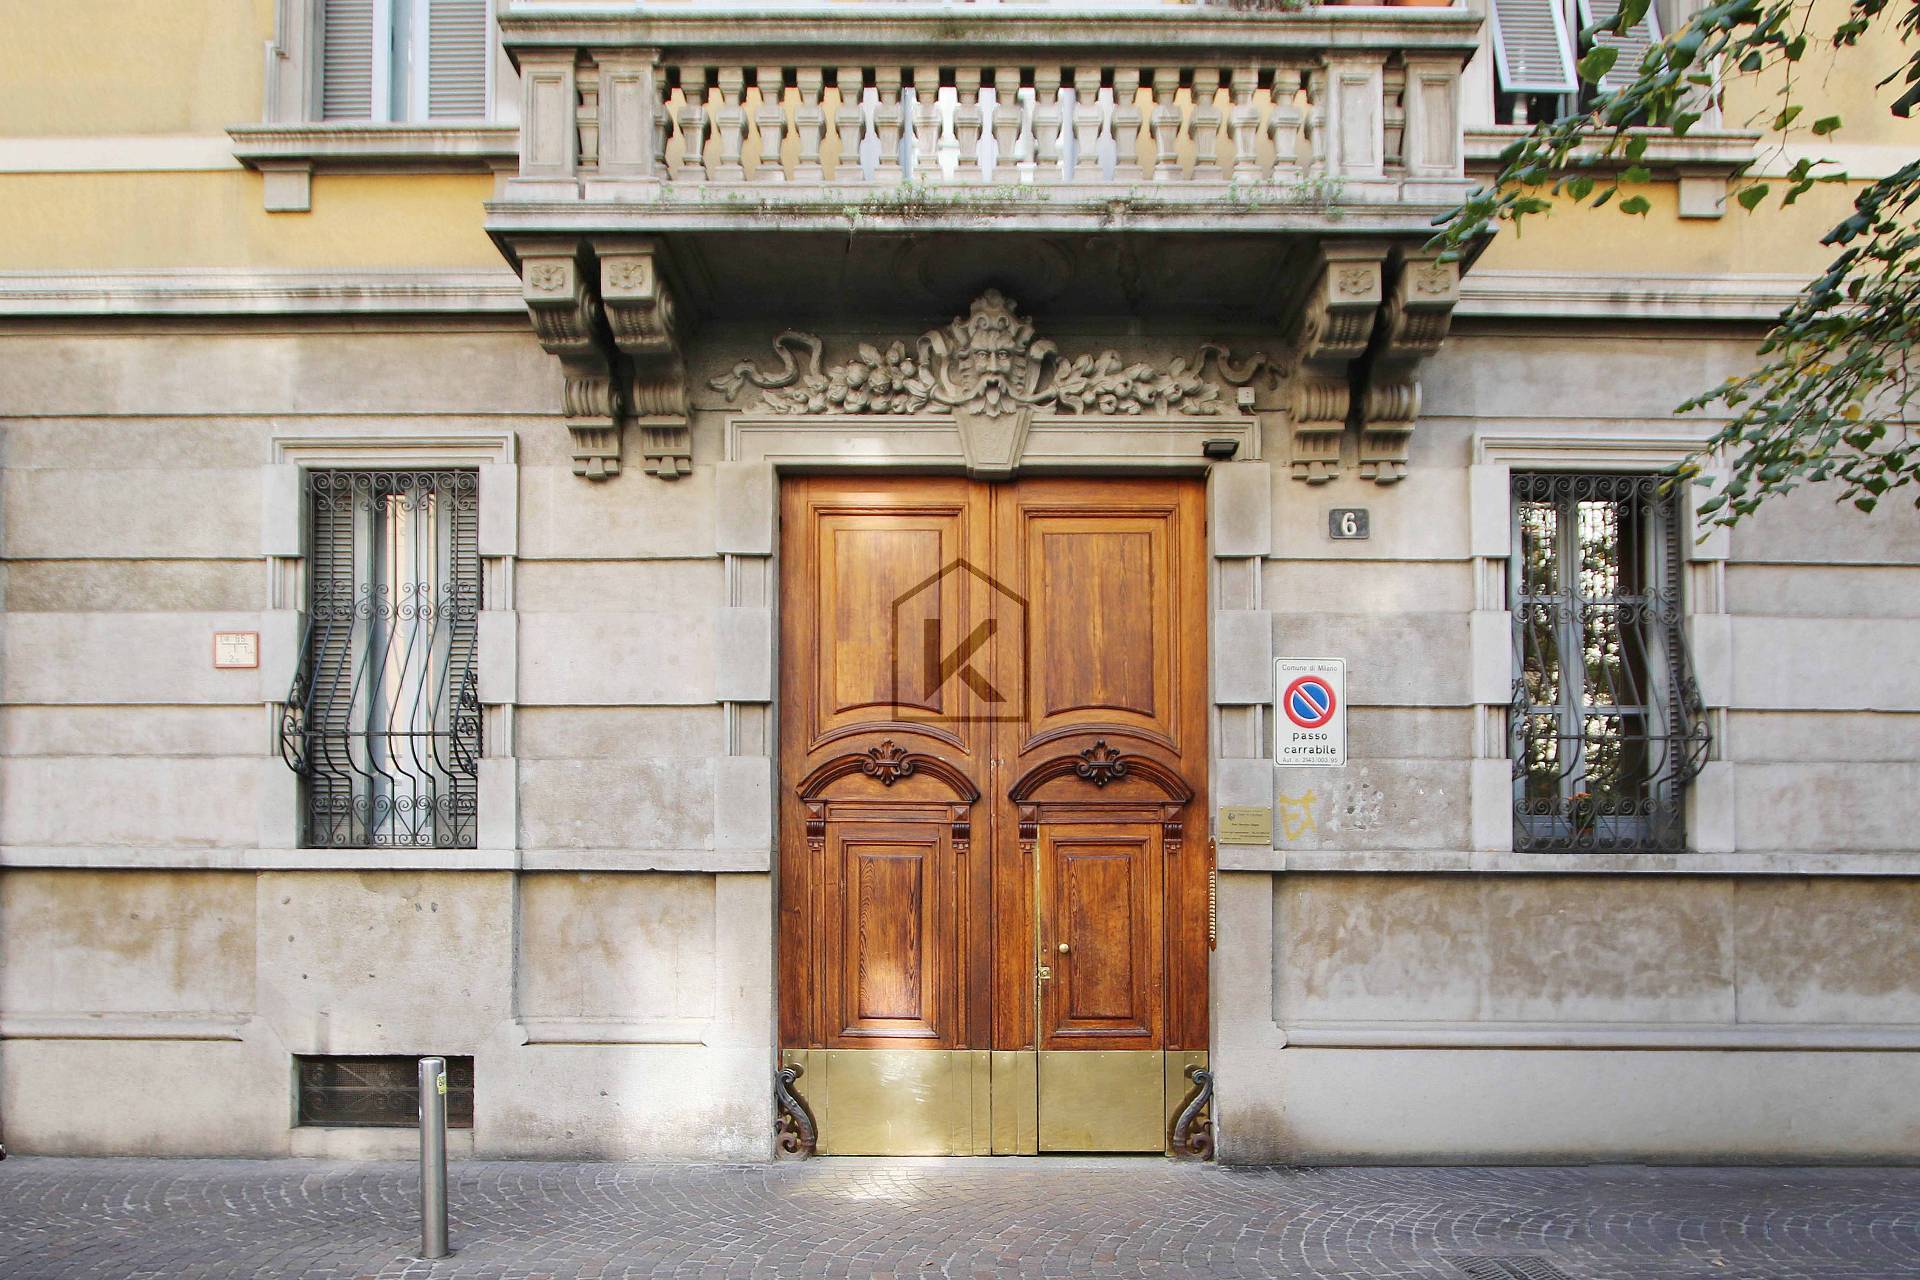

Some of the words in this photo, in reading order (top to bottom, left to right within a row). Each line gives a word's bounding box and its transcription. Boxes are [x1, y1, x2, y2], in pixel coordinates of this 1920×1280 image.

[1342, 512, 1357, 536] 6
[1281, 664, 1307, 672] Comune
[1309, 664, 1316, 672] di
[1292, 732, 1328, 741] passo
[1284, 744, 1337, 755] carrabile
